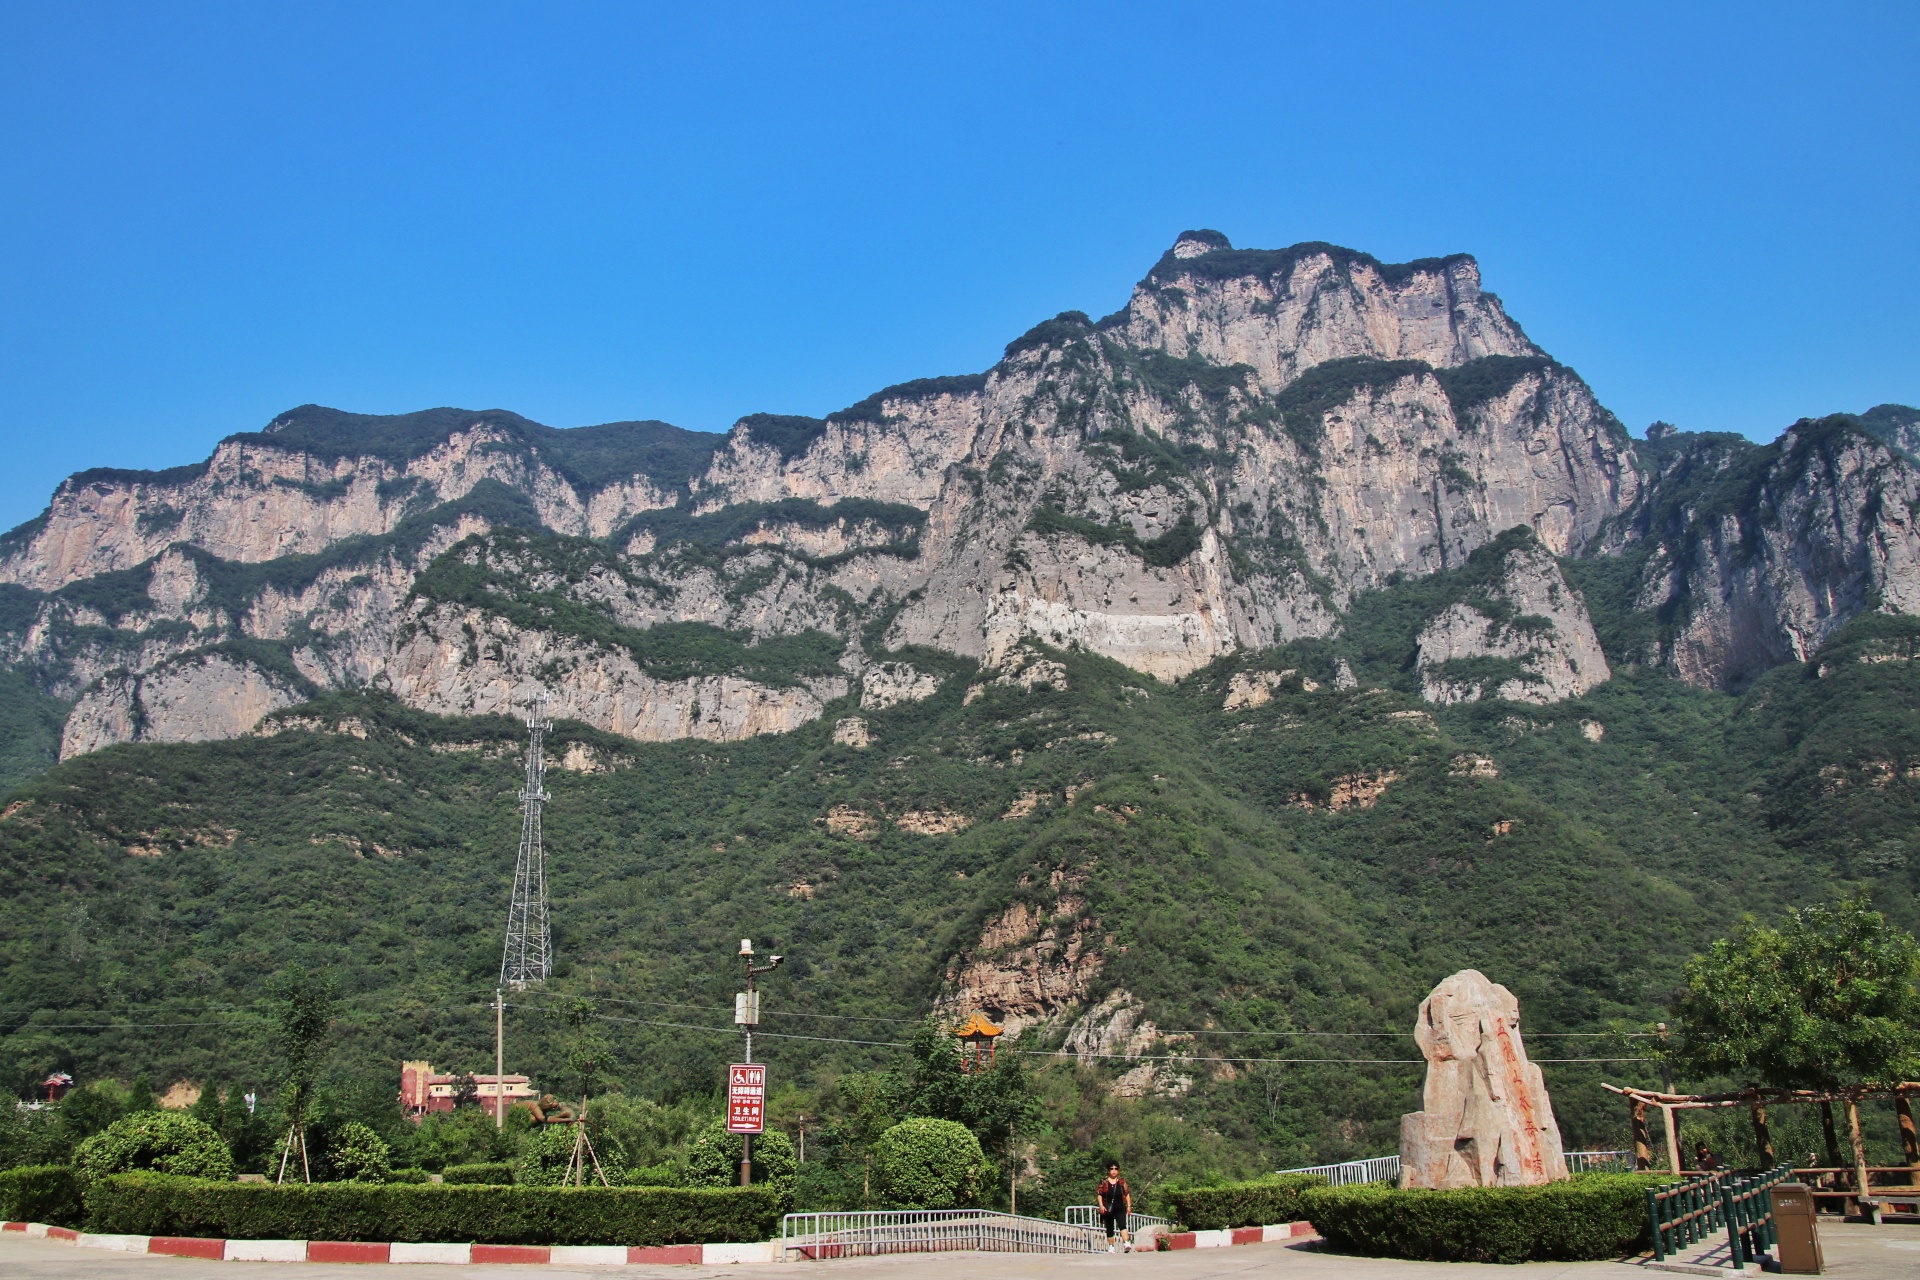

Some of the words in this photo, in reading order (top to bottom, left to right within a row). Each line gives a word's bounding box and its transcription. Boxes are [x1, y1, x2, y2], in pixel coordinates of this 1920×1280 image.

[732, 1087, 762, 1095] 无障碍通道
[734, 1106, 759, 1115] 卫生间
